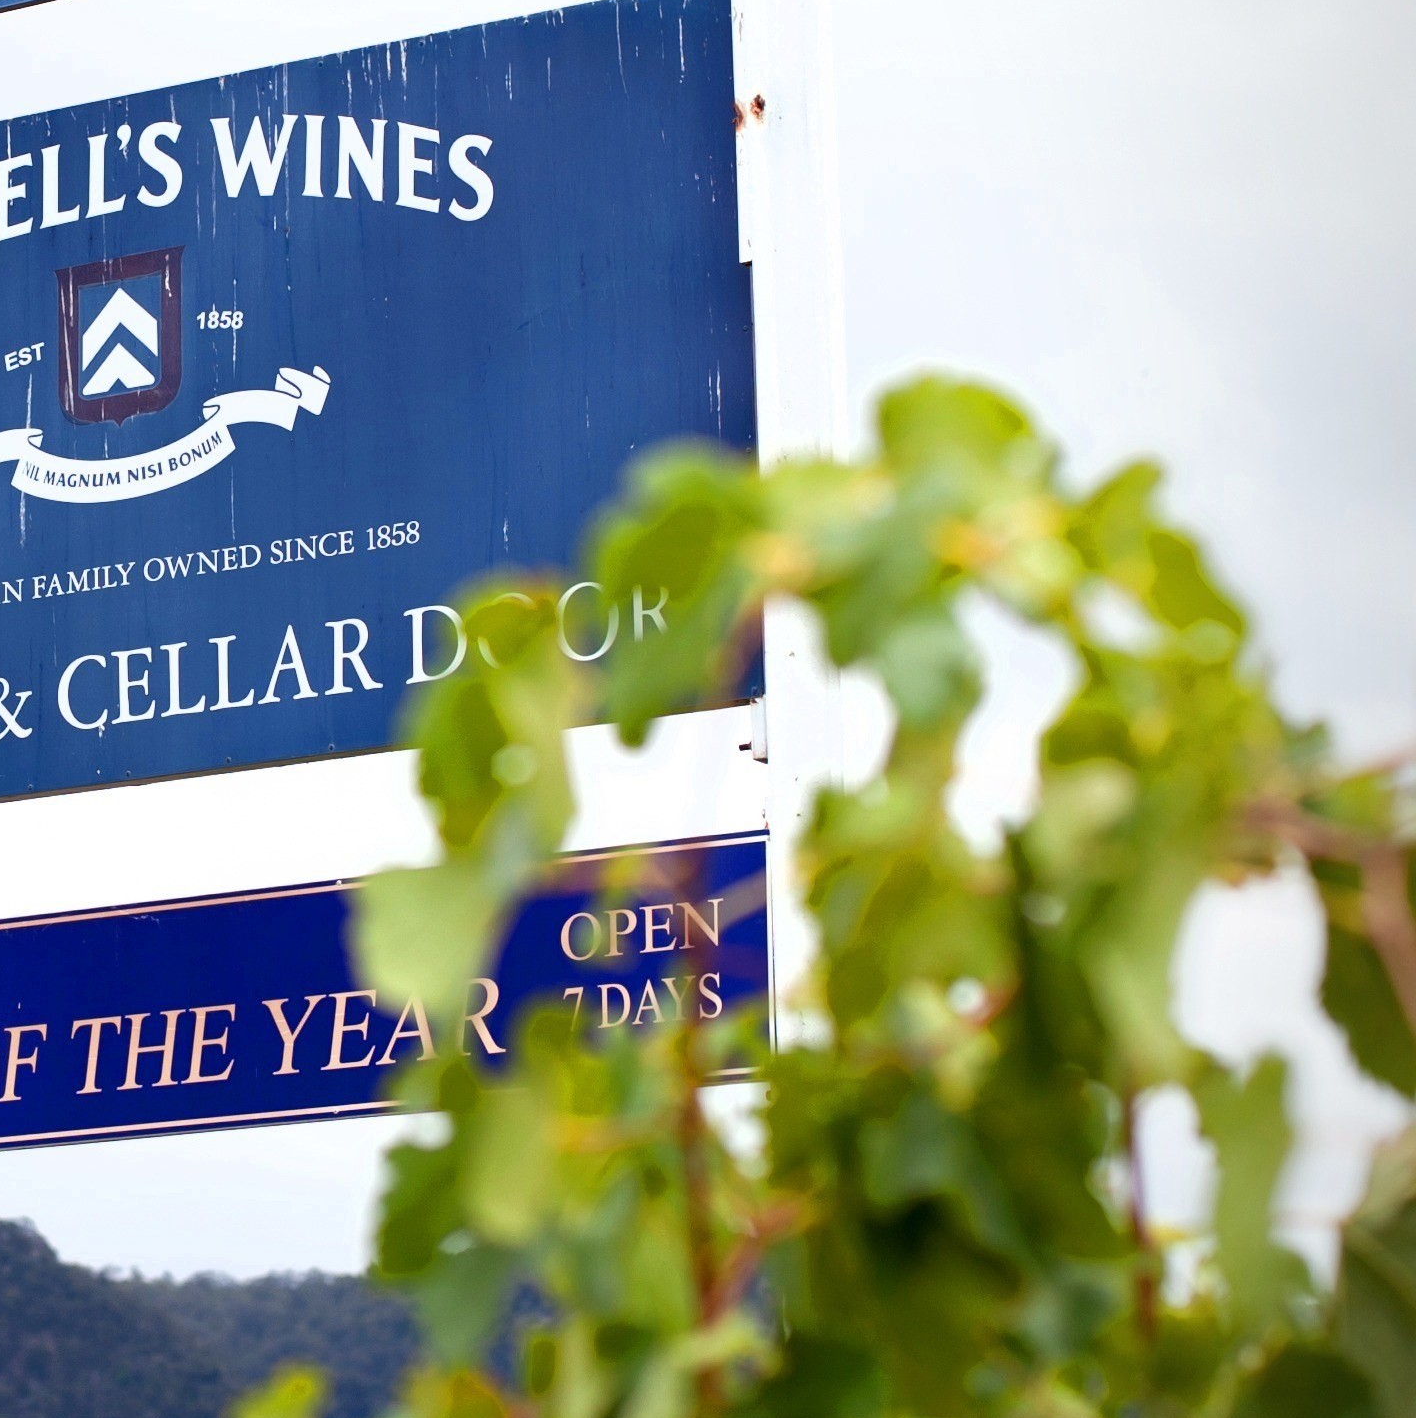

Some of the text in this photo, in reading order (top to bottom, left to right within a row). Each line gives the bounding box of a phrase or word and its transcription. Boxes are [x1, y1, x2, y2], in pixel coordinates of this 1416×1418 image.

[212, 114, 494, 223] WINES
[4, 311, 244, 372] EST 1858
[43, 470, 121, 488] MAGNUM
[127, 462, 163, 483] NISI
[168, 431, 223, 473] BONUM
[32, 561, 135, 599] FAMILY
[143, 544, 262, 582] OWNED
[269, 531, 355, 565] SINCE
[366, 521, 420, 552] 1858
[56, 616, 383, 734] CELLAR
[560, 898, 724, 961] OPEN
[71, 1004, 239, 1096] THE
[262, 977, 506, 1076] YEAR
[562, 972, 723, 1032] 7 DAYS
